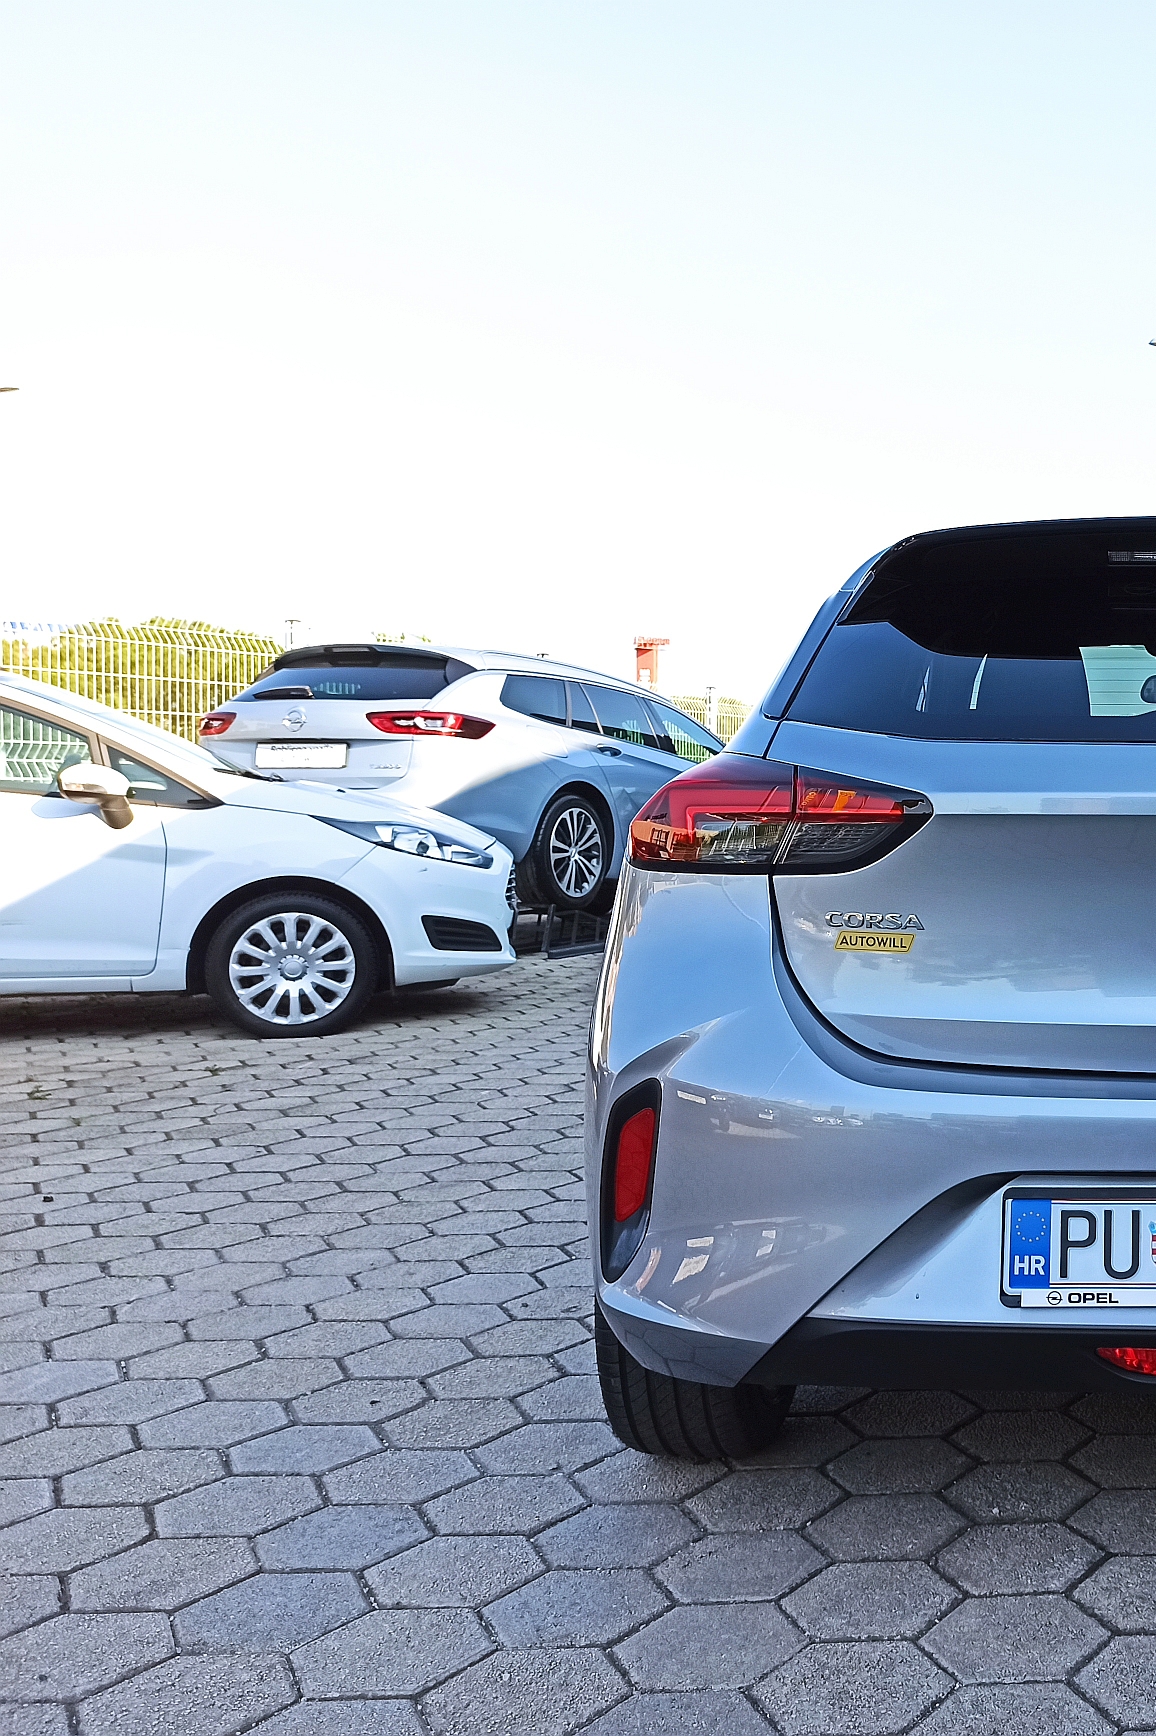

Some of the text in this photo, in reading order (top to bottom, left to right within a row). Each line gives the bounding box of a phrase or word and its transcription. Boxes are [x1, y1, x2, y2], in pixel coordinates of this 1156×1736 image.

[824, 910, 925, 930] CORSA
[839, 935, 907, 948] AUTOWILL
[1013, 1255, 1046, 1276] HR
[1067, 1292, 1119, 1305] OPEL
